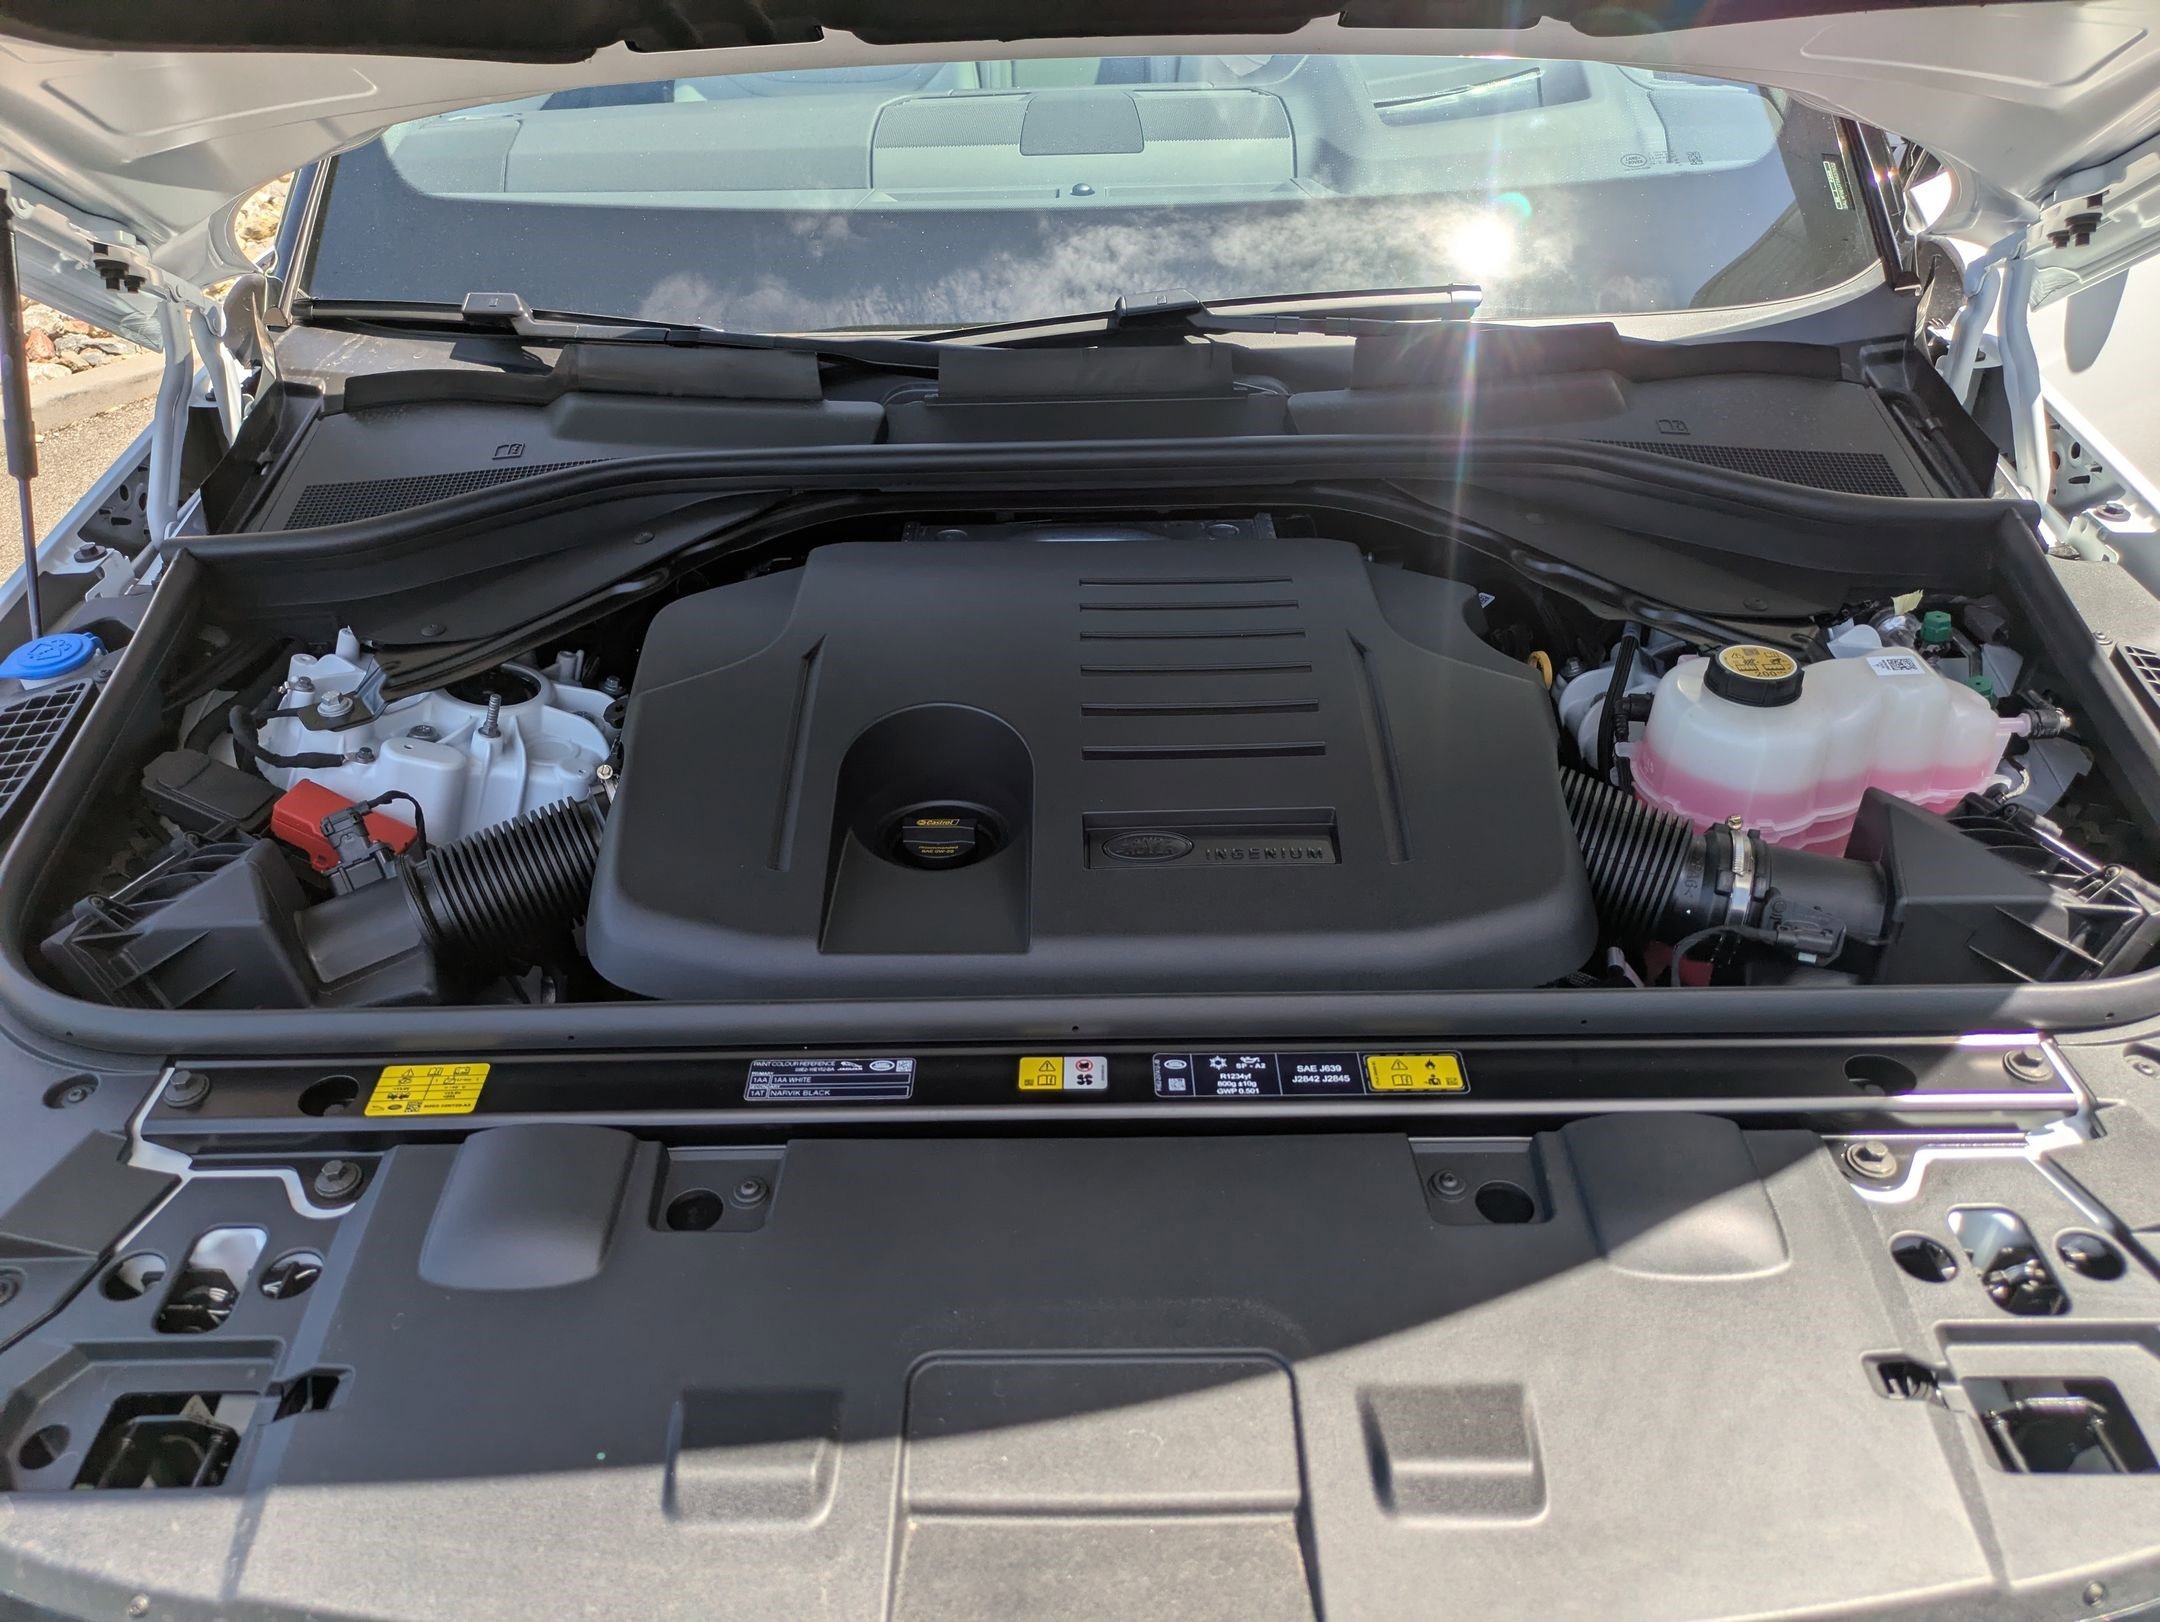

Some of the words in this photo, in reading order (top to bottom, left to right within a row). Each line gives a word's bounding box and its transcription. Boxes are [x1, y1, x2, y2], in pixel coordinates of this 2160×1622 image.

[926, 818, 953, 826] Castrol
[1205, 847, 1323, 861] INGENIUM
[1296, 1064, 1318, 1073] SAE
[1319, 1064, 1342, 1073] J639
[1219, 1073, 1252, 1081] R1234yf
[1291, 1075, 1320, 1083] J2842
[1322, 1074, 1351, 1083] J2845
